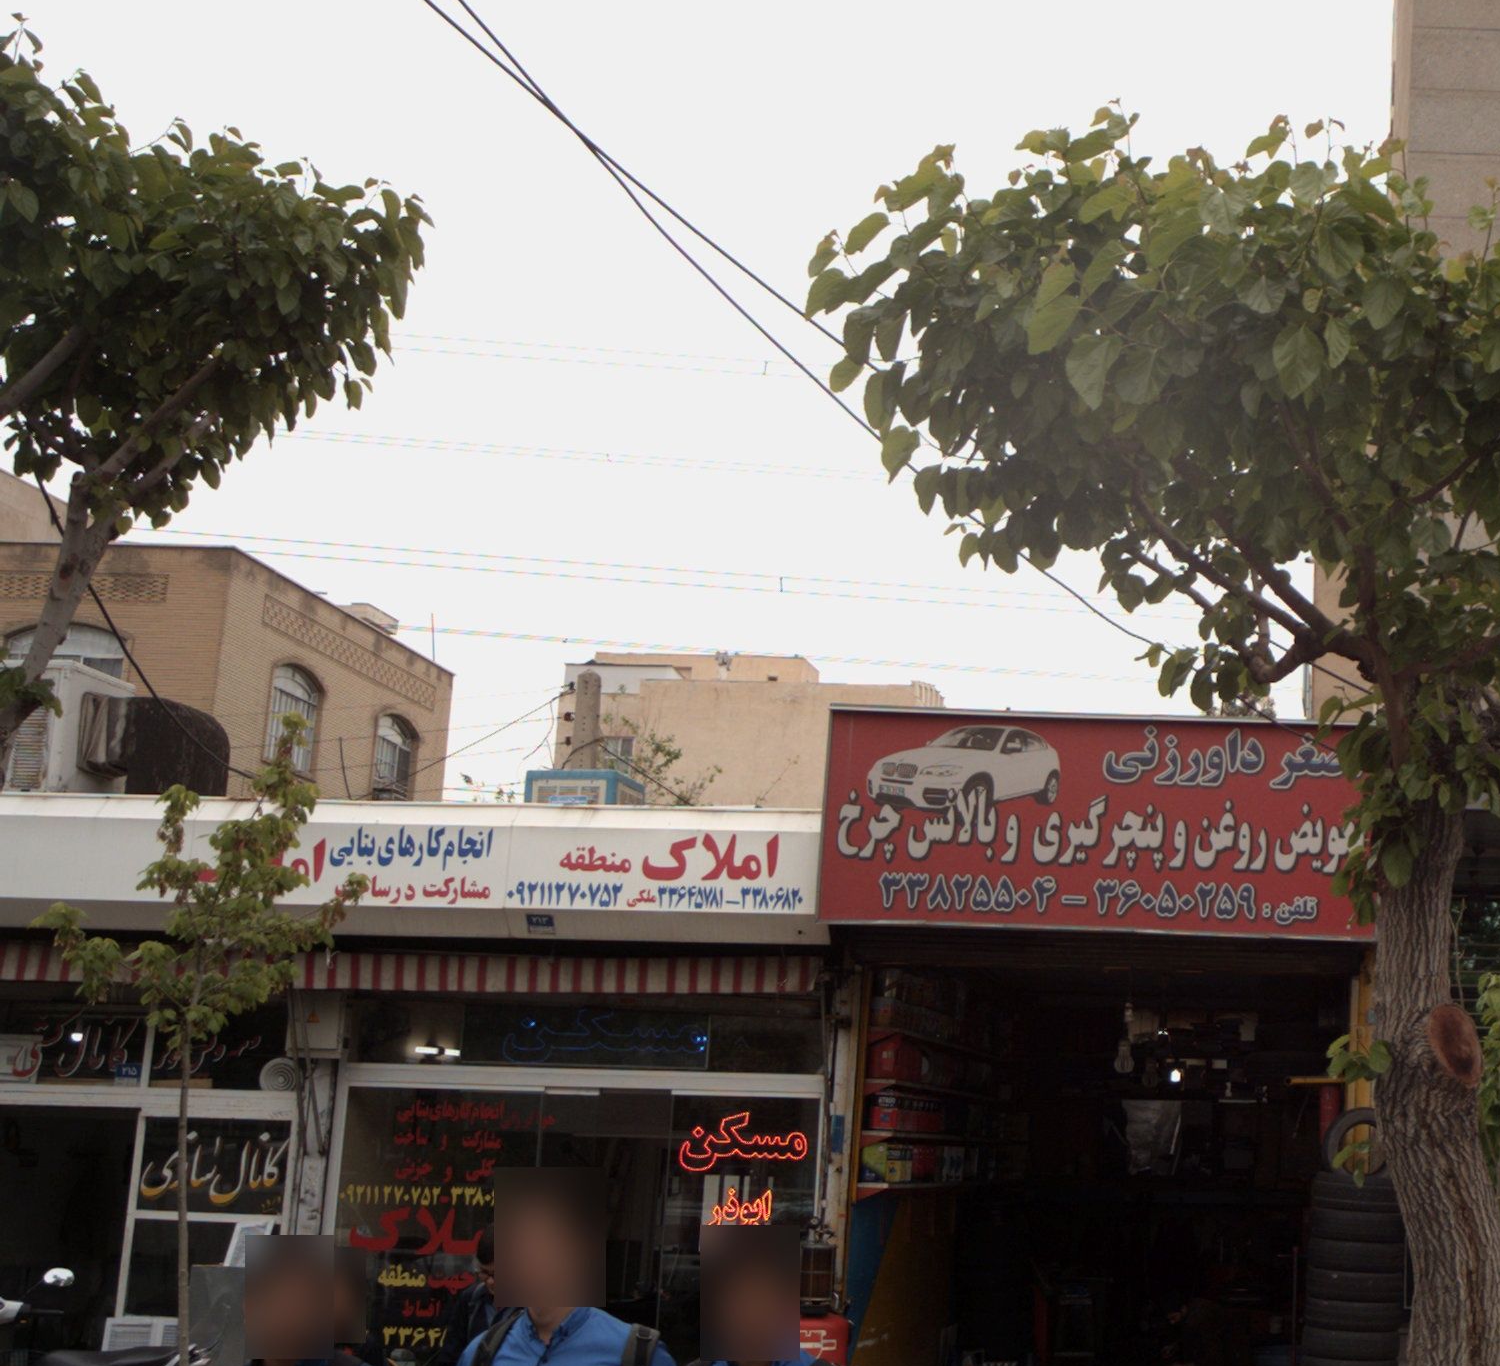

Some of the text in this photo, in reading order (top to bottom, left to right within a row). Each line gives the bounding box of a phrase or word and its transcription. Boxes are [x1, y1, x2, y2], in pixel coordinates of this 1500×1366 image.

[1102, 725, 1363, 789] صغر داورزنی
[329, 826, 376, 867] بنایی
[837, 789, 902, 861] چرخ
[907, 785, 997, 861] بالانس
[1001, 813, 1020, 863] و
[1167, 819, 1188, 869] و
[1193, 800, 1268, 871] روغن
[1274, 803, 1367, 875] عویض
[377, 827, 446, 867] کارهای
[443, 827, 494, 871] انجام
[559, 832, 780, 882] املاک منطقه
[422, 875, 491, 905] مشارکت
[506, 880, 623, 908] ۰۹۲۱۱۲۷۰۷۵۲
[657, 885, 724, 910] ۳۳۶۴۵۷۸۱
[879, 871, 1057, 914] ۳۳۸۲۵۵۰۴
[1094, 878, 1256, 921] ۳۶۰۵۰۲۵۹
[502, 1009, 709, 1063] مسکن
[121, 1066, 138, 1077] ۲۱۵
[462, 1132, 503, 1153] مشارکت
[678, 1111, 808, 1172] مسکن
[208, 1131, 290, 1207] کانال
[377, 1264, 426, 1288] منطقه
